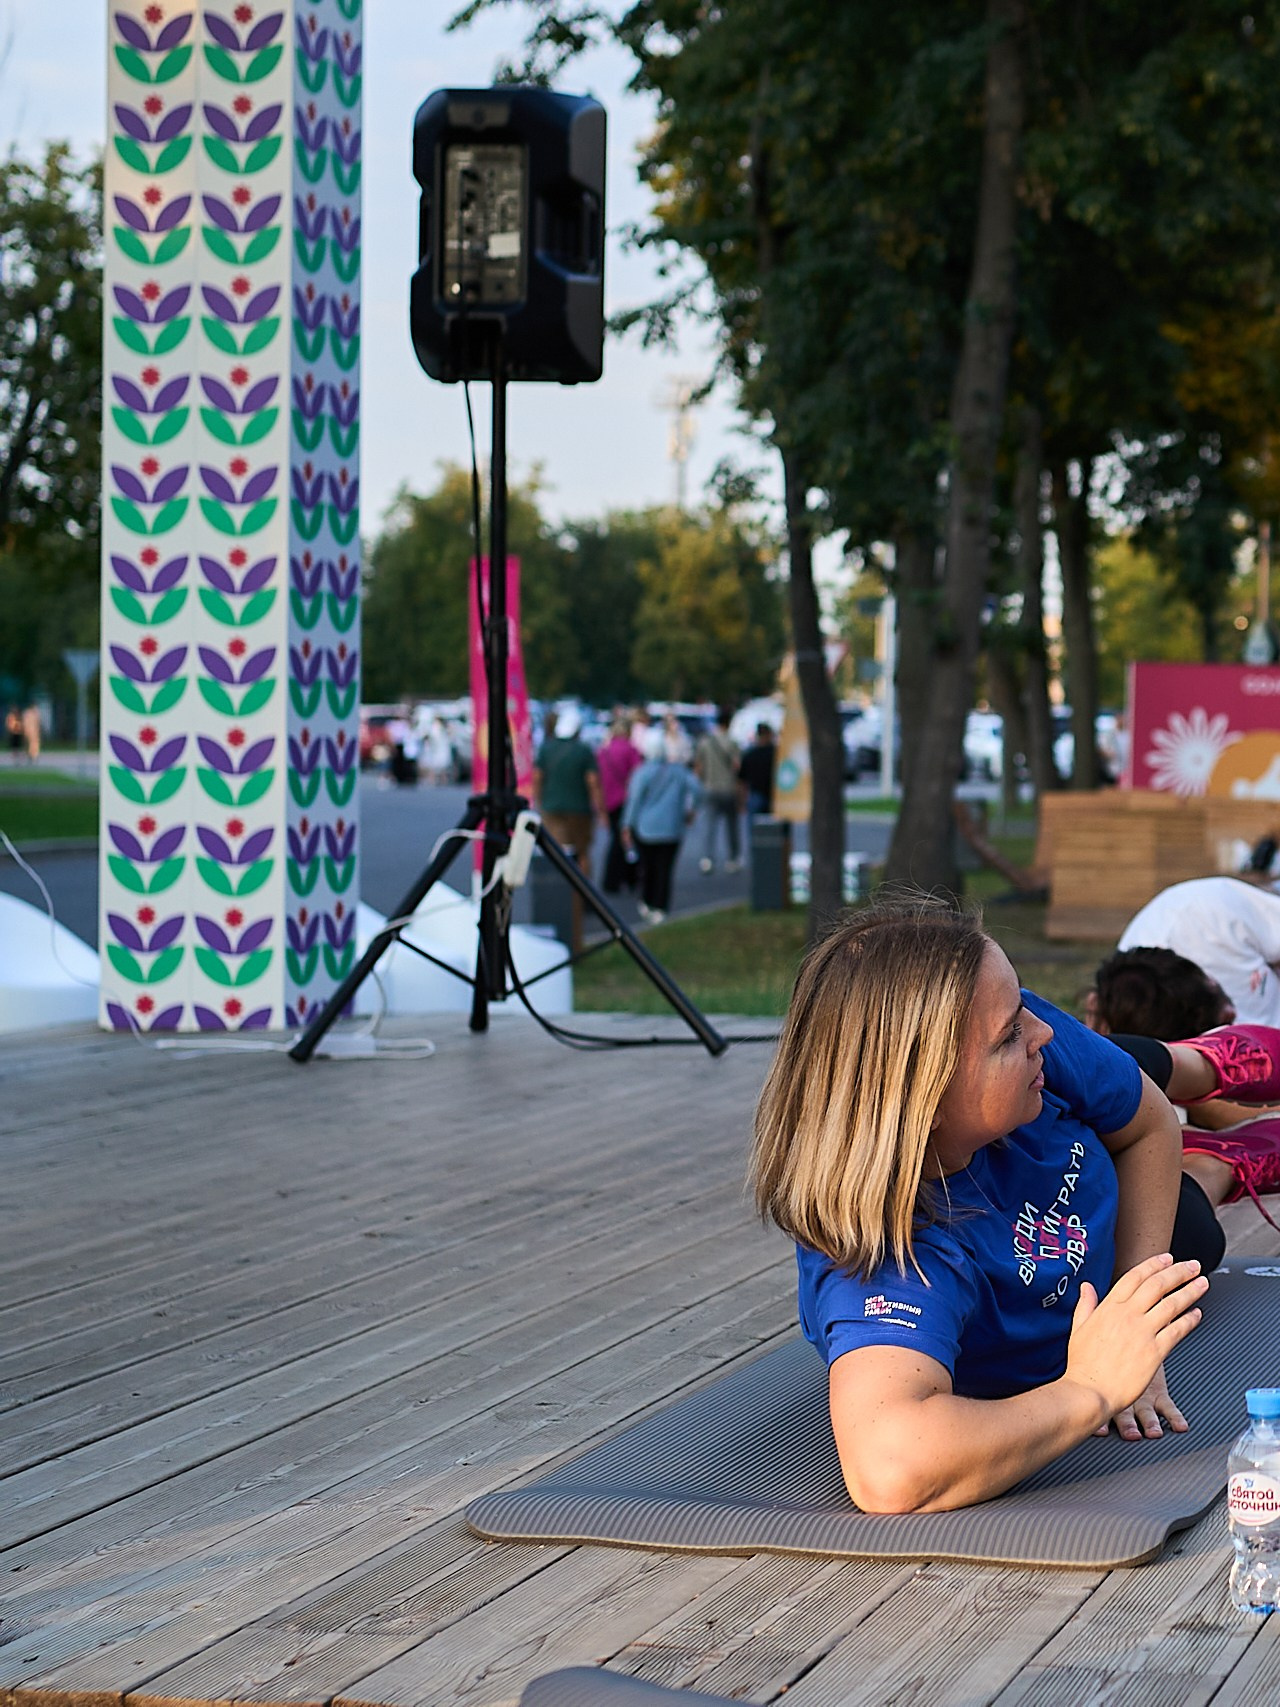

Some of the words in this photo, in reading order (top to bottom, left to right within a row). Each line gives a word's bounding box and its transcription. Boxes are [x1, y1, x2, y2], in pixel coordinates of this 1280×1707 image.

[1013, 1201, 1040, 1286] ВЫХОДИ
[1039, 1141, 1085, 1259] ПОИГРАТЬ
[1042, 1275, 1069, 1308] ВО
[1066, 1214, 1088, 1276] ДВОР
[864, 1301, 922, 1316] СПОРТИВНЫЙ
